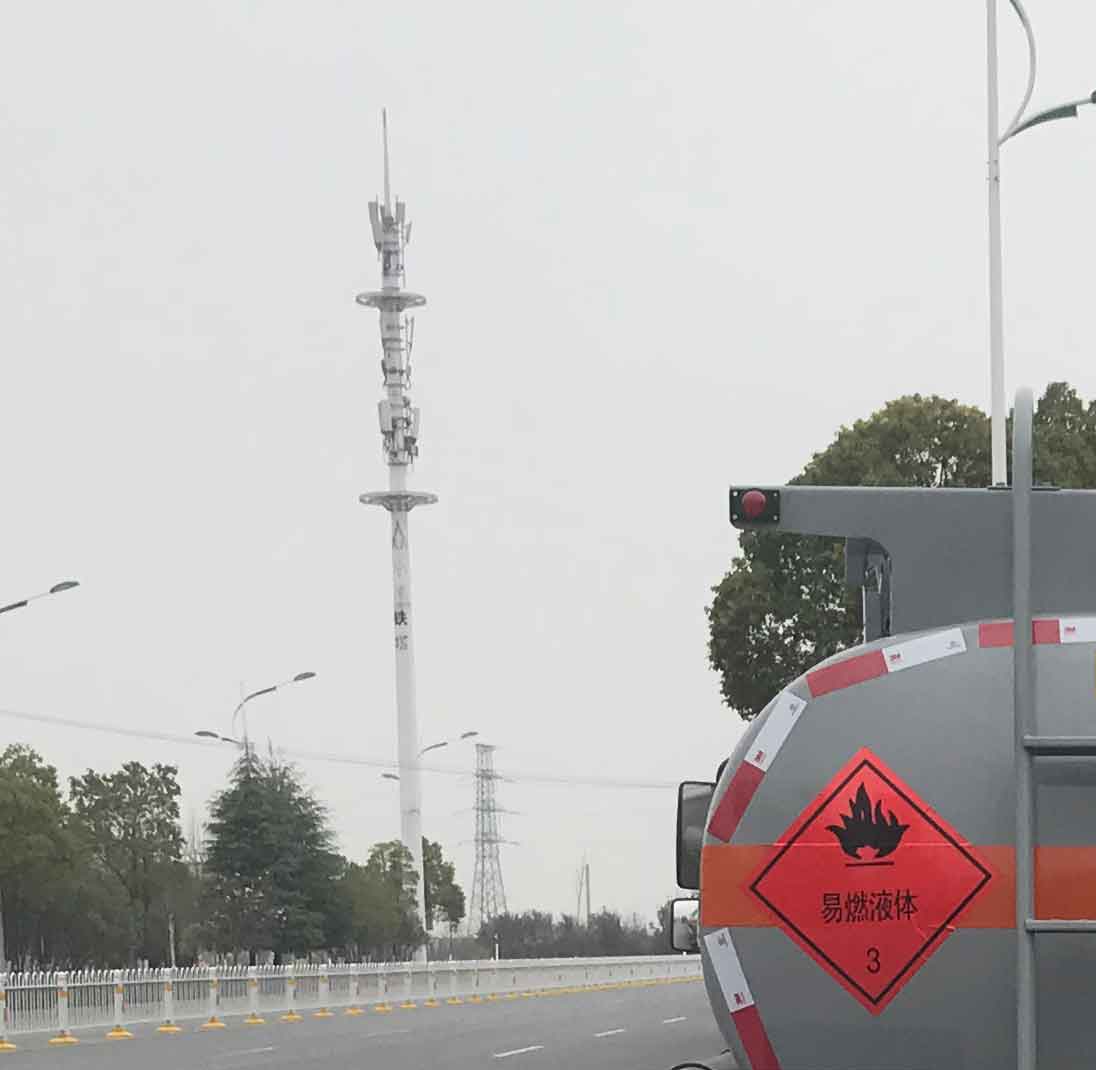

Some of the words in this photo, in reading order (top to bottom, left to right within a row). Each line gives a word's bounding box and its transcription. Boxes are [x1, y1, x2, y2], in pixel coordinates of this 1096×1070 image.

[821, 889, 918, 924] 易燃液体
[866, 947, 881, 974] 3
